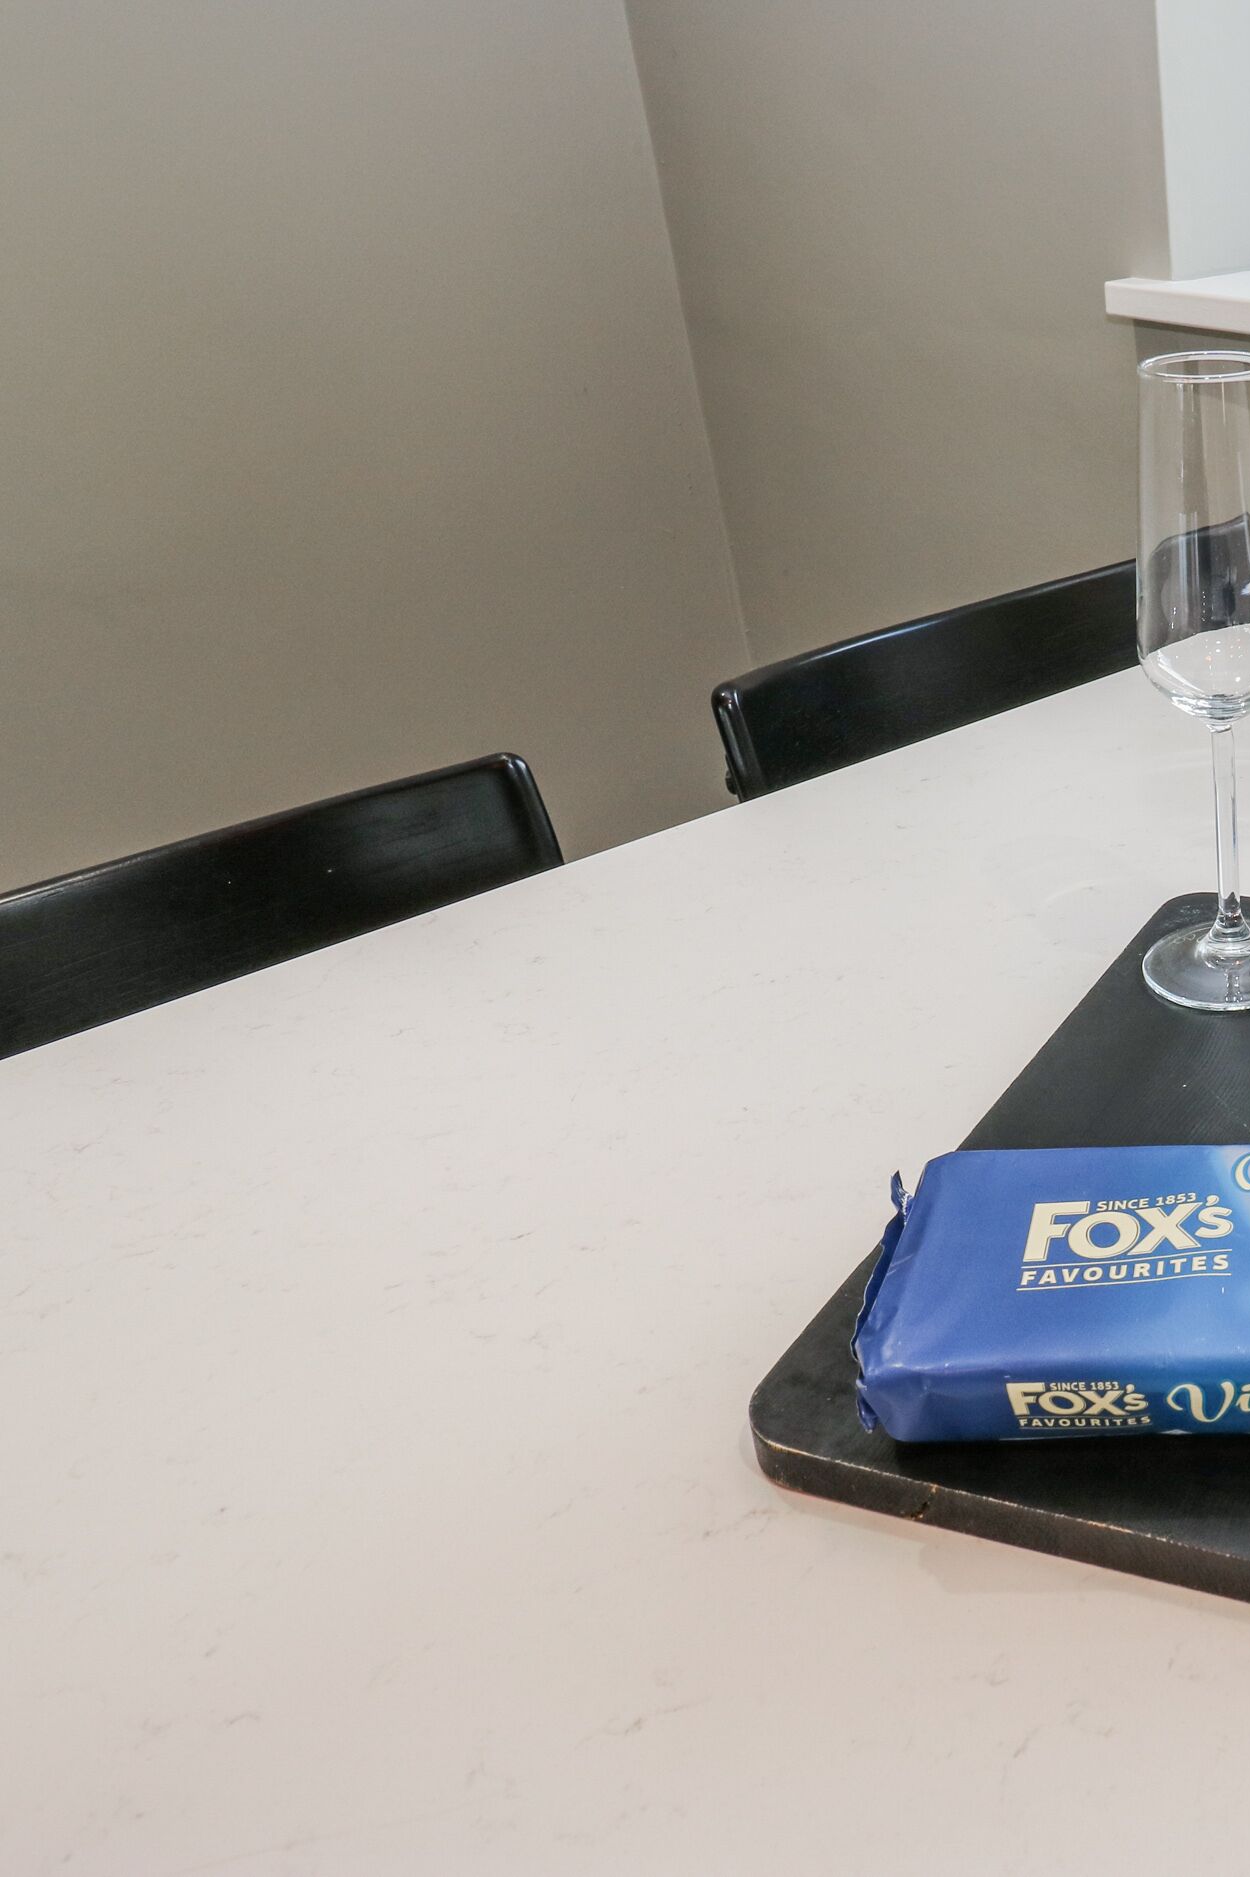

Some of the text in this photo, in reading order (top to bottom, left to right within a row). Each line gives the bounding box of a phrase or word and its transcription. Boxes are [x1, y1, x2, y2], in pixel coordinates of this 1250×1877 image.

[1096, 1192, 1196, 1212] SINCE 1853
[1020, 1254, 1229, 1286] FAVOURITES
[1050, 1381, 1119, 1391] SINCE 1853
[1019, 1415, 1151, 1428] FAVOURITES
